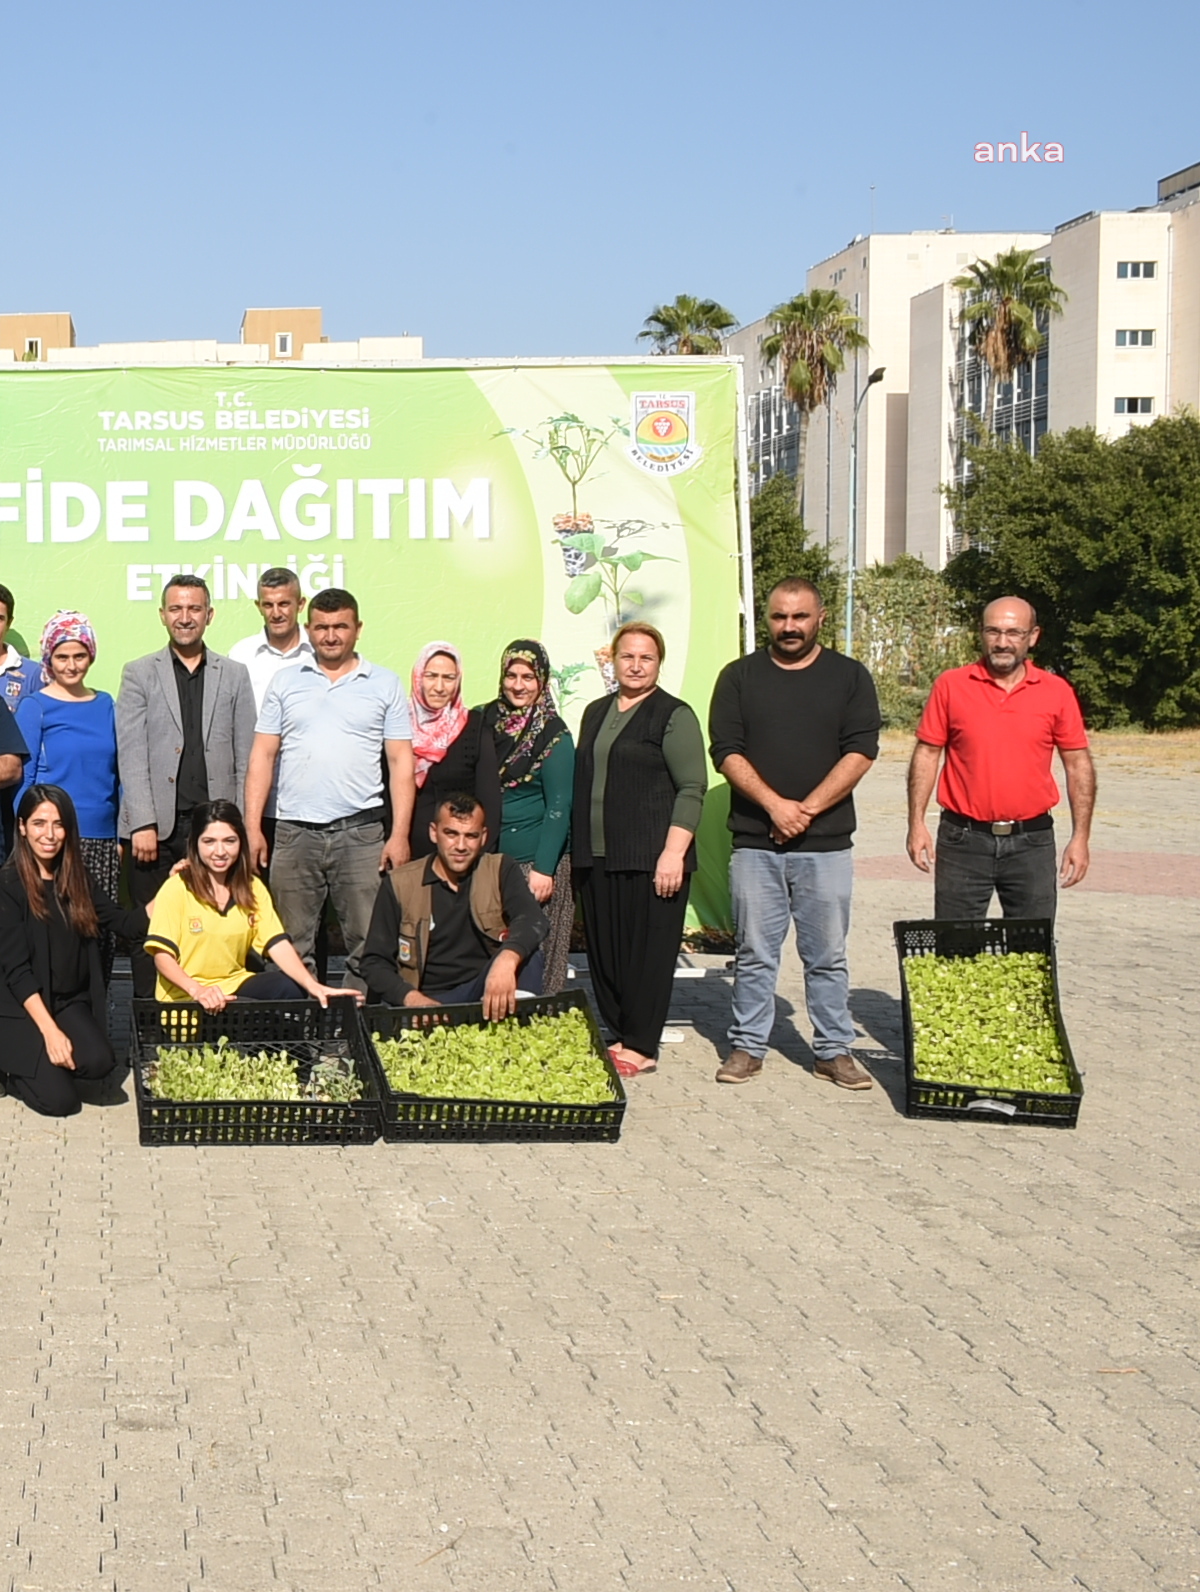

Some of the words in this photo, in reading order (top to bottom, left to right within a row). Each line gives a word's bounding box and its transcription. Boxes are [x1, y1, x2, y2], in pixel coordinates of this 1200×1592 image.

[215, 391, 253, 407] T.C.
[638, 400, 686, 409] TARSUS
[98, 410, 205, 430] TARSUS
[215, 407, 370, 430] BELEDİYESİ
[98, 437, 175, 451] TARIMSAL
[180, 434, 267, 451] HİZMETLER
[272, 433, 371, 450] MÜDÜRLÜĞÜ
[173, 463, 491, 542] DAĞITIM
